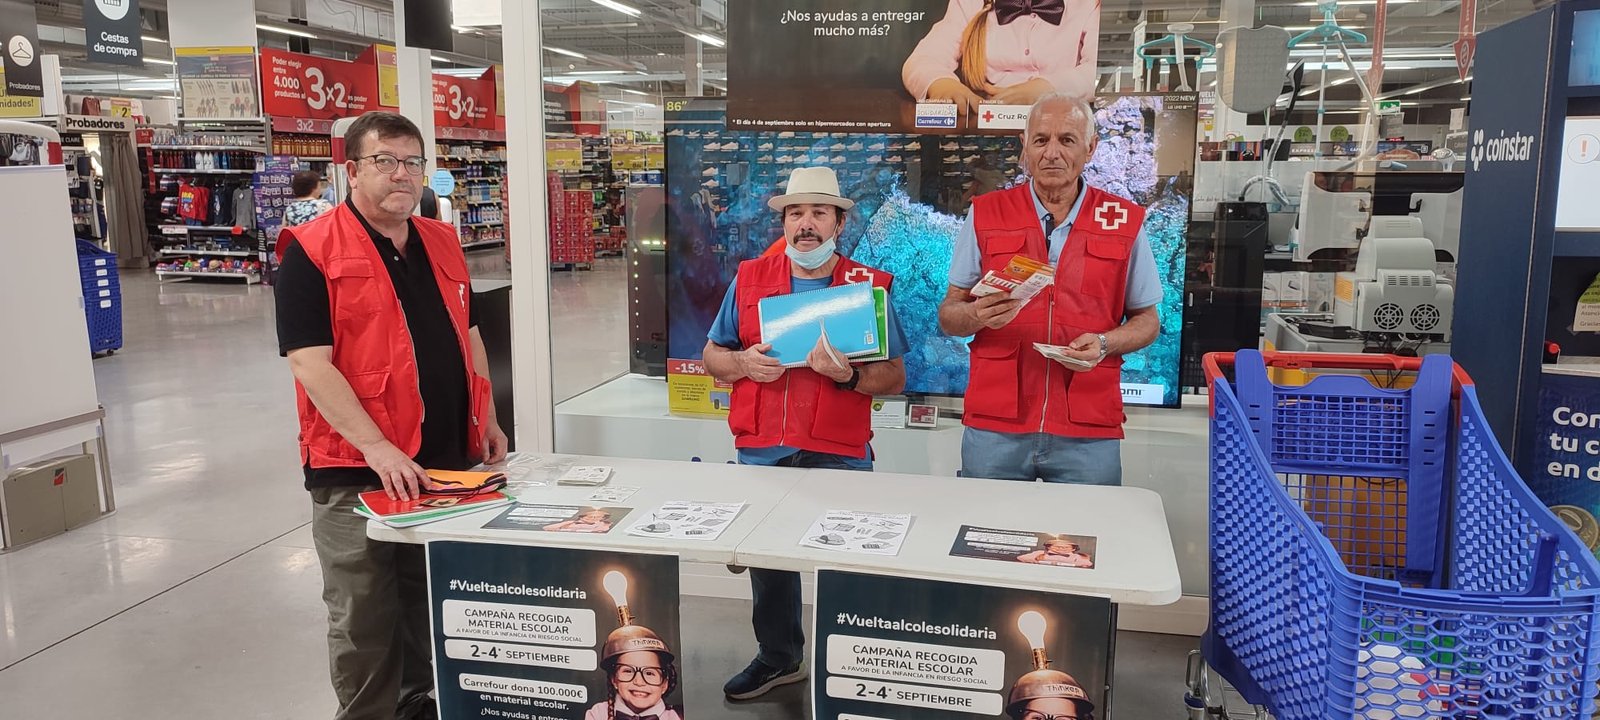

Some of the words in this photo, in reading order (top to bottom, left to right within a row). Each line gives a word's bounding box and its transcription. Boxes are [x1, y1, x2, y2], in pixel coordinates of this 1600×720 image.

[780, 9, 811, 24] ¿Nos
[814, 9, 858, 24] ayudas
[861, 12, 869, 21] a
[872, 10, 925, 24] entregar
[101, 31, 129, 44] Cestas
[813, 24, 855, 36] mucho
[858, 24, 890, 36] más?
[93, 42, 105, 53] de
[106, 46, 138, 57] compra
[272, 56, 288, 66] Poder
[9, 81, 41, 91] Probadores
[274, 75, 300, 90] 4.000
[274, 90, 301, 99] productos
[65, 117, 125, 129] Probadores
[296, 120, 314, 132] 3x2
[1486, 129, 1535, 162] coinstar
[675, 362, 705, 374] -15%
[1549, 432, 1578, 453] tu
[1547, 461, 1580, 479] en
[449, 579, 587, 600] #Vueltaalcolesolidaria
[464, 608, 516, 620] CAMPAÑA
[518, 612, 572, 625] RECOGIDA
[468, 618, 519, 631] MATERIAL
[521, 622, 569, 635] ESCOLAR
[836, 612, 997, 640] #Vueltaalcolesolidaria
[561, 635, 583, 643] SOCIAL
[505, 650, 571, 664] SEPTIEMBRE
[852, 644, 912, 659] CAMPAÑA
[915, 650, 978, 665] RECOGIDA
[856, 656, 914, 671] MATERIAL
[917, 662, 974, 676] ESCOLAR
[871, 667, 881, 675] DE
[892, 670, 924, 678] INFANCIA
[936, 675, 962, 683] RIESGO
[963, 677, 989, 685] SOCIAL
[463, 677, 509, 690] Carrefour
[511, 684, 535, 693] dona
[538, 686, 584, 699] 100.000€
[493, 694, 532, 706] material
[533, 699, 570, 711] escolar.
[896, 691, 973, 707] SEPTIEMBRE
[480, 707, 500, 716] ¿Nos
[501, 710, 530, 720] ayudas
